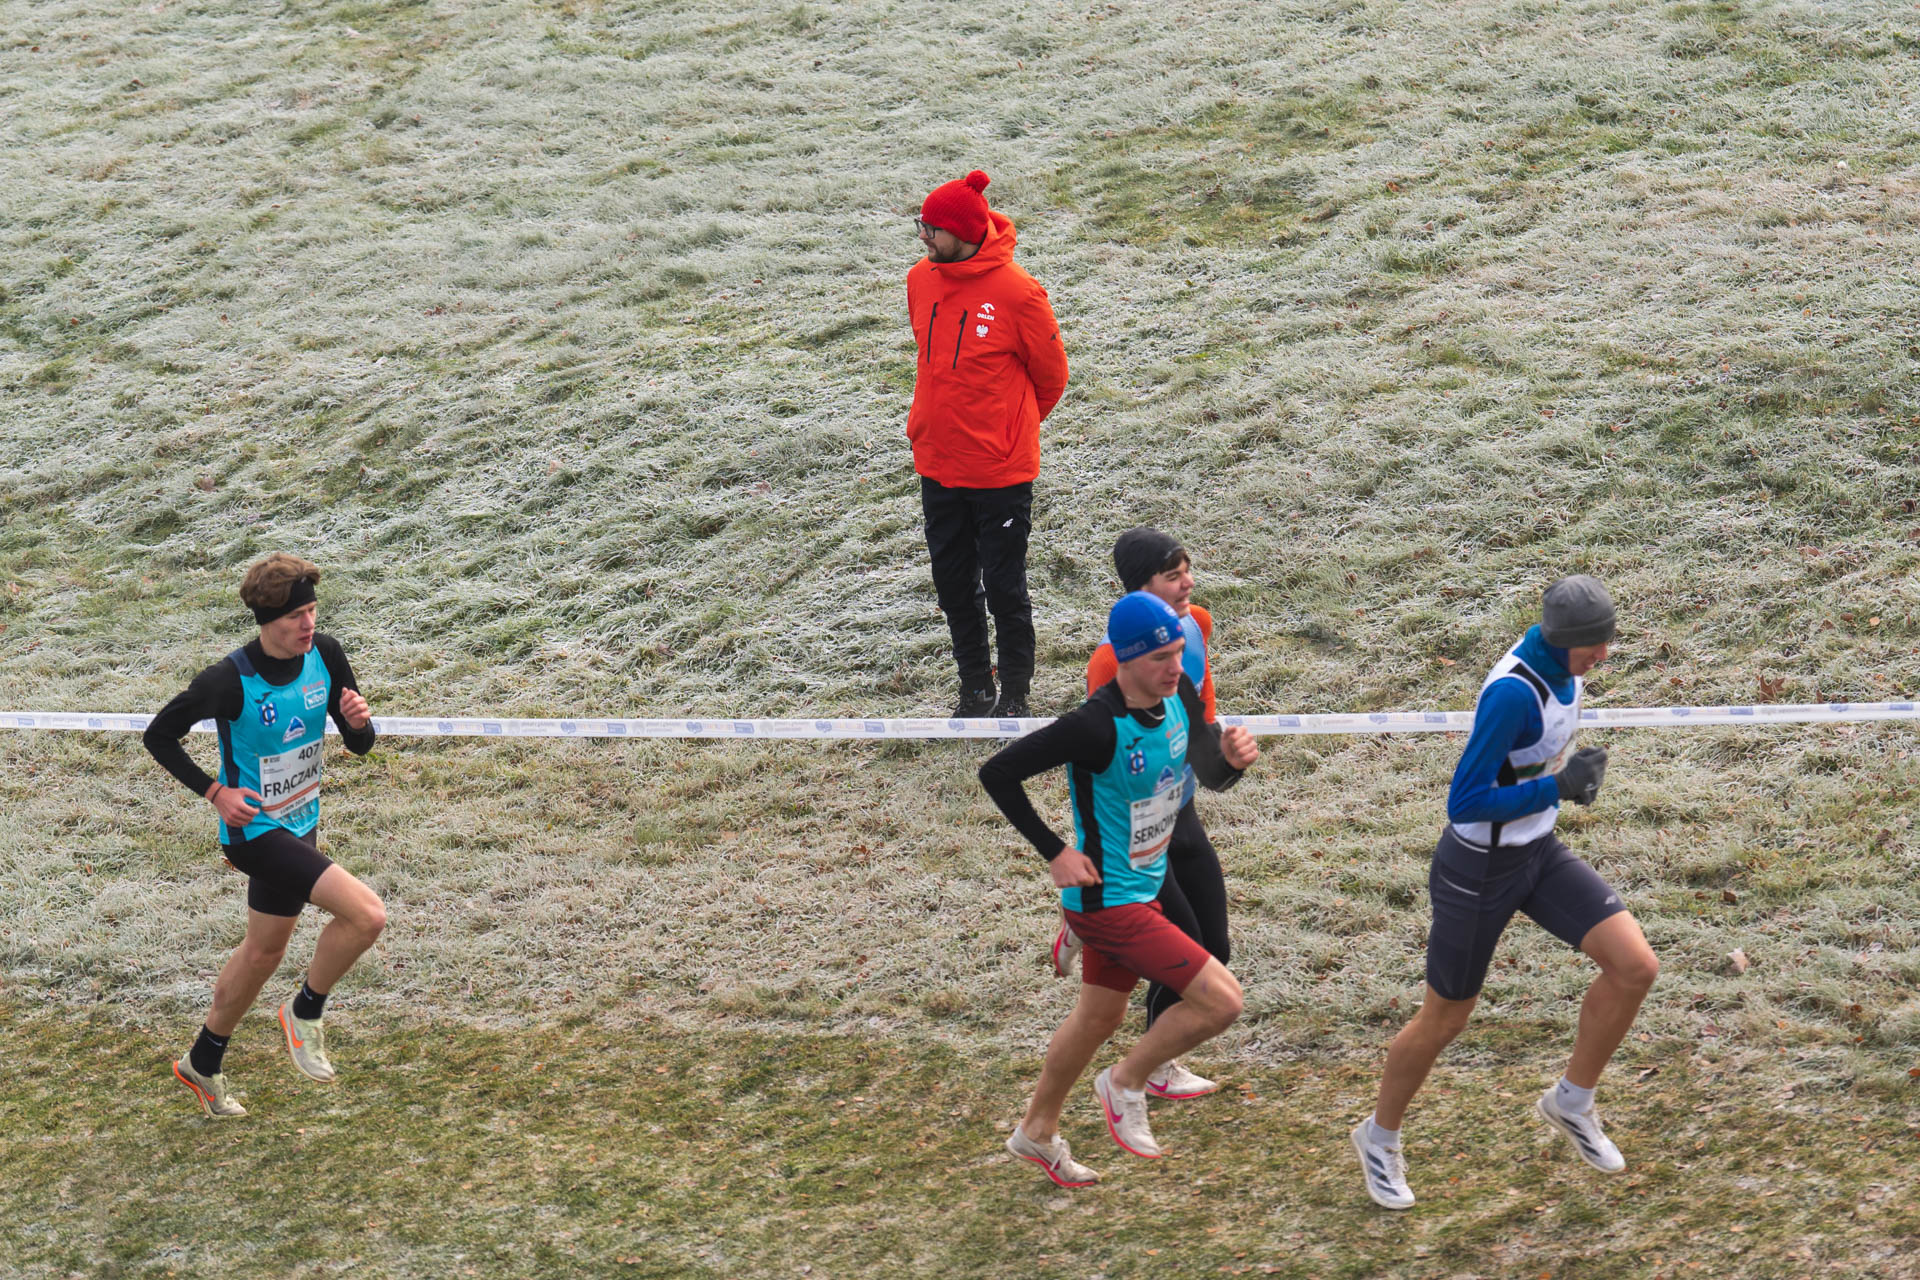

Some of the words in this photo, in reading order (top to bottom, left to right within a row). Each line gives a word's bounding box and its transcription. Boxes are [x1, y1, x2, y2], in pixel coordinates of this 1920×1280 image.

[976, 312, 995, 321] ORLEN
[298, 743, 320, 761] 407
[264, 762, 318, 798] FRĄCZAK
[1167, 783, 1184, 801] 41
